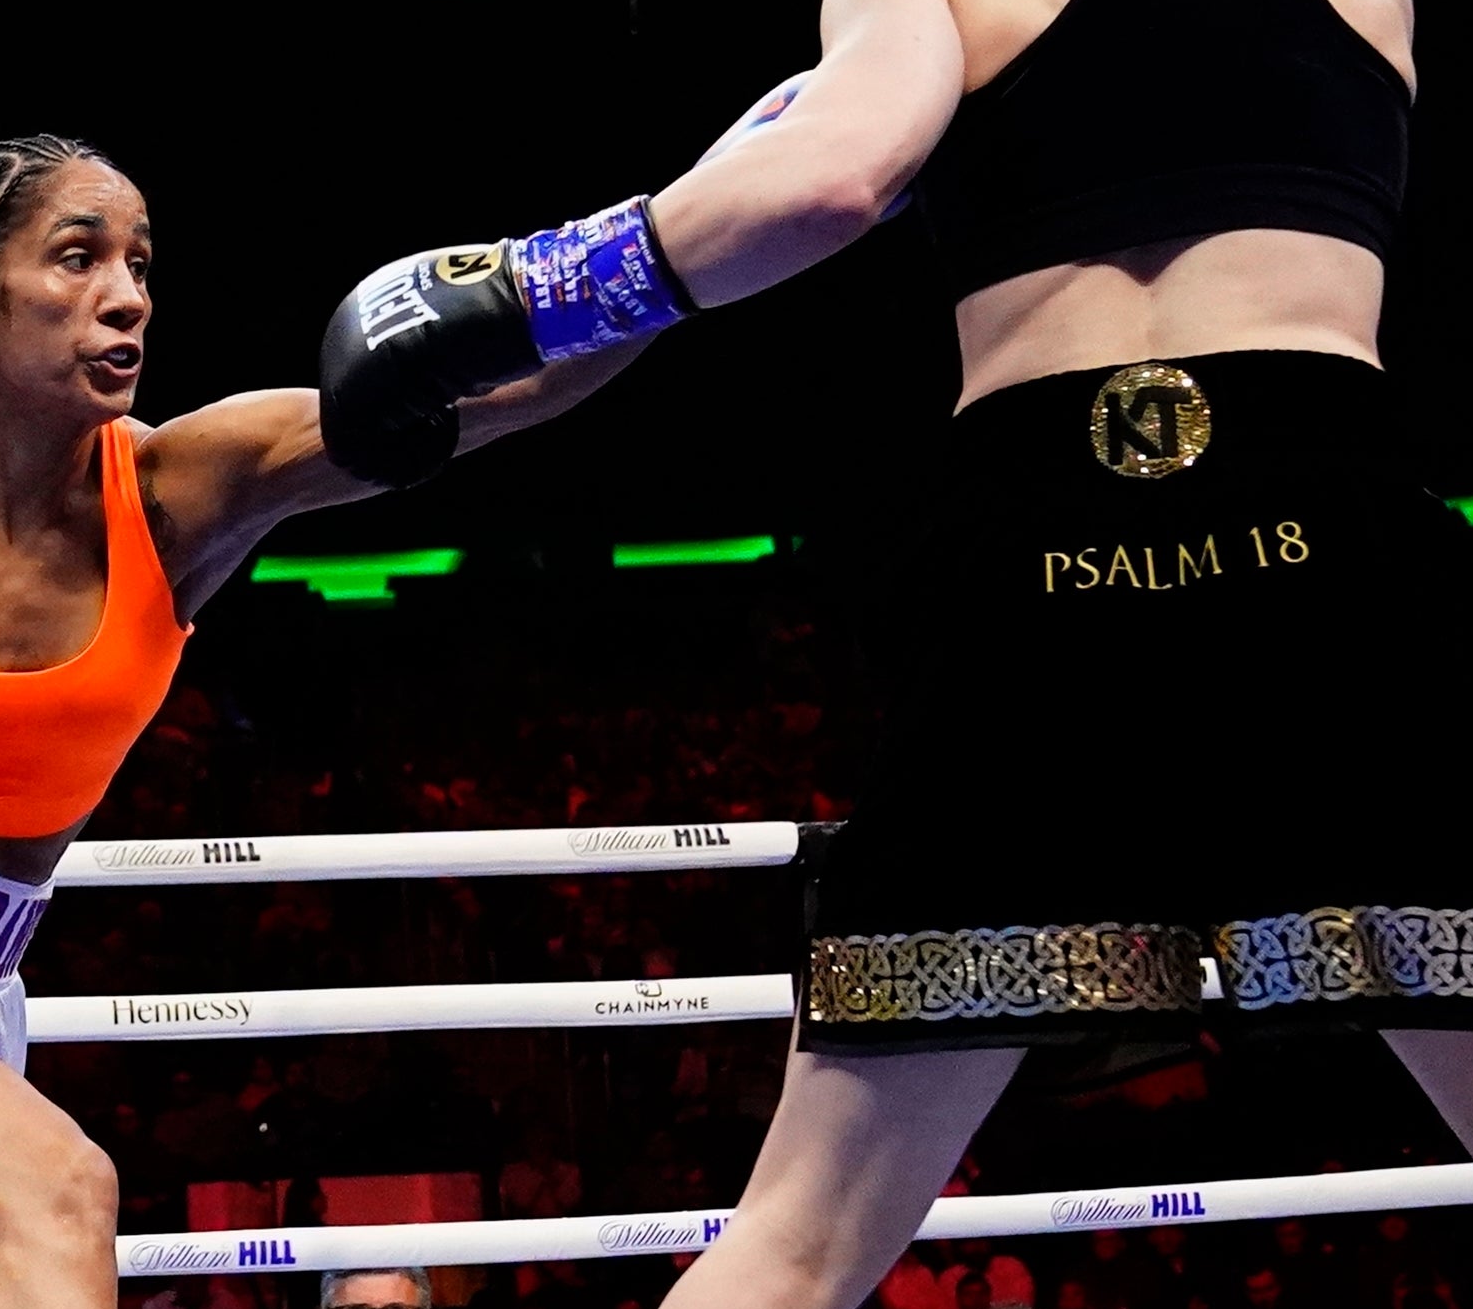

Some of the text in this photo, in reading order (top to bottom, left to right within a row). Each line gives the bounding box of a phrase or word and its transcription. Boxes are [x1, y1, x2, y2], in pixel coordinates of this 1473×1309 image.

[1105, 386, 1197, 466] KT
[1044, 521, 1310, 593] PSALM 18
[93, 841, 261, 872] William HILL
[566, 827, 731, 858] William HILL
[112, 997, 254, 1026] Hennessy
[594, 996, 710, 1015] CHAINMYNE
[1051, 1191, 1205, 1227] William HILL
[598, 1220, 701, 1253] William
[129, 1240, 297, 1274] William HILL
